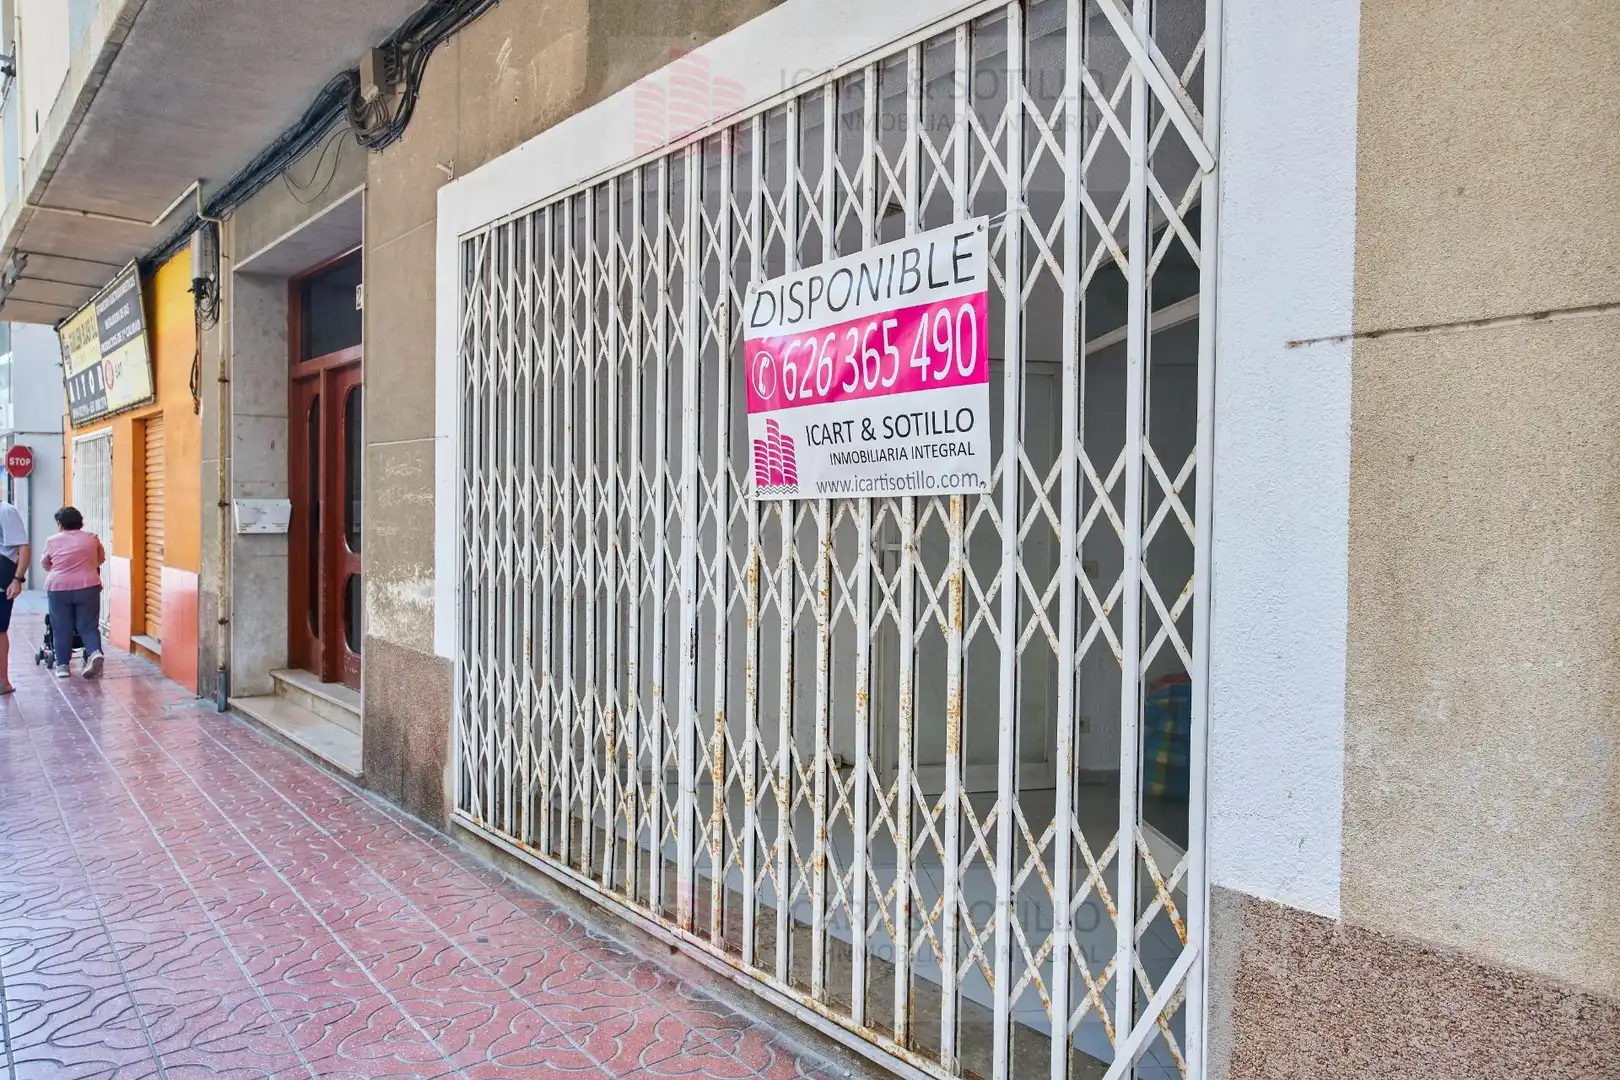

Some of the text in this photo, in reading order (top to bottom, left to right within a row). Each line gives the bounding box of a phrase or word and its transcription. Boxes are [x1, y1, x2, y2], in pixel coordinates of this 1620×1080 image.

[750, 231, 976, 328] DISPONIBLE
[783, 303, 977, 401] 626 365 490
[69, 364, 104, 404] AITOR
[806, 407, 975, 446] ICART & SOTILLO
[9, 457, 31, 466] STOP
[829, 441, 975, 466] INMOBILIARIA INTEGRAL
[816, 470, 979, 494] www.icartisotillo.com
